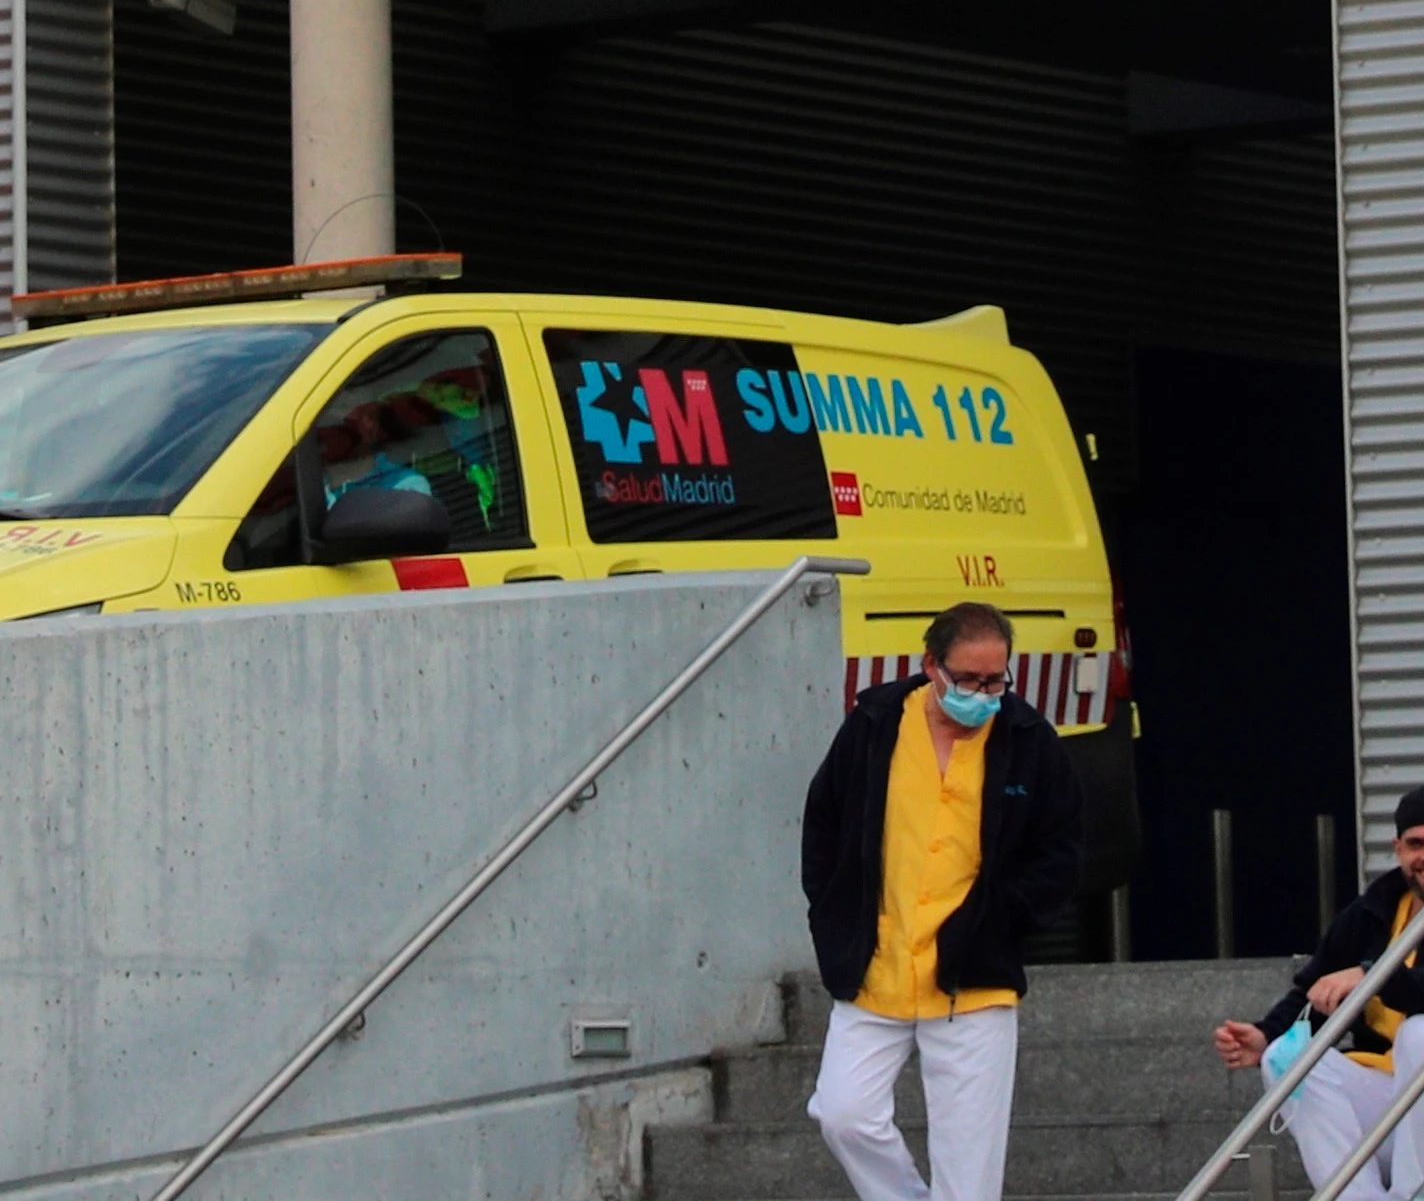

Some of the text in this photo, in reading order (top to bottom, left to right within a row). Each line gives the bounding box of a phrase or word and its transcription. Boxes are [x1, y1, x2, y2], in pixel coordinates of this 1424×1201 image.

[736, 367, 1014, 445] SUMMA 112
[601, 470, 735, 504] SaludMadrid
[862, 483, 1026, 516] Comunidad de Madrid
[956, 554, 1005, 587] V.I.R.
[175, 581, 241, 603] M-786
